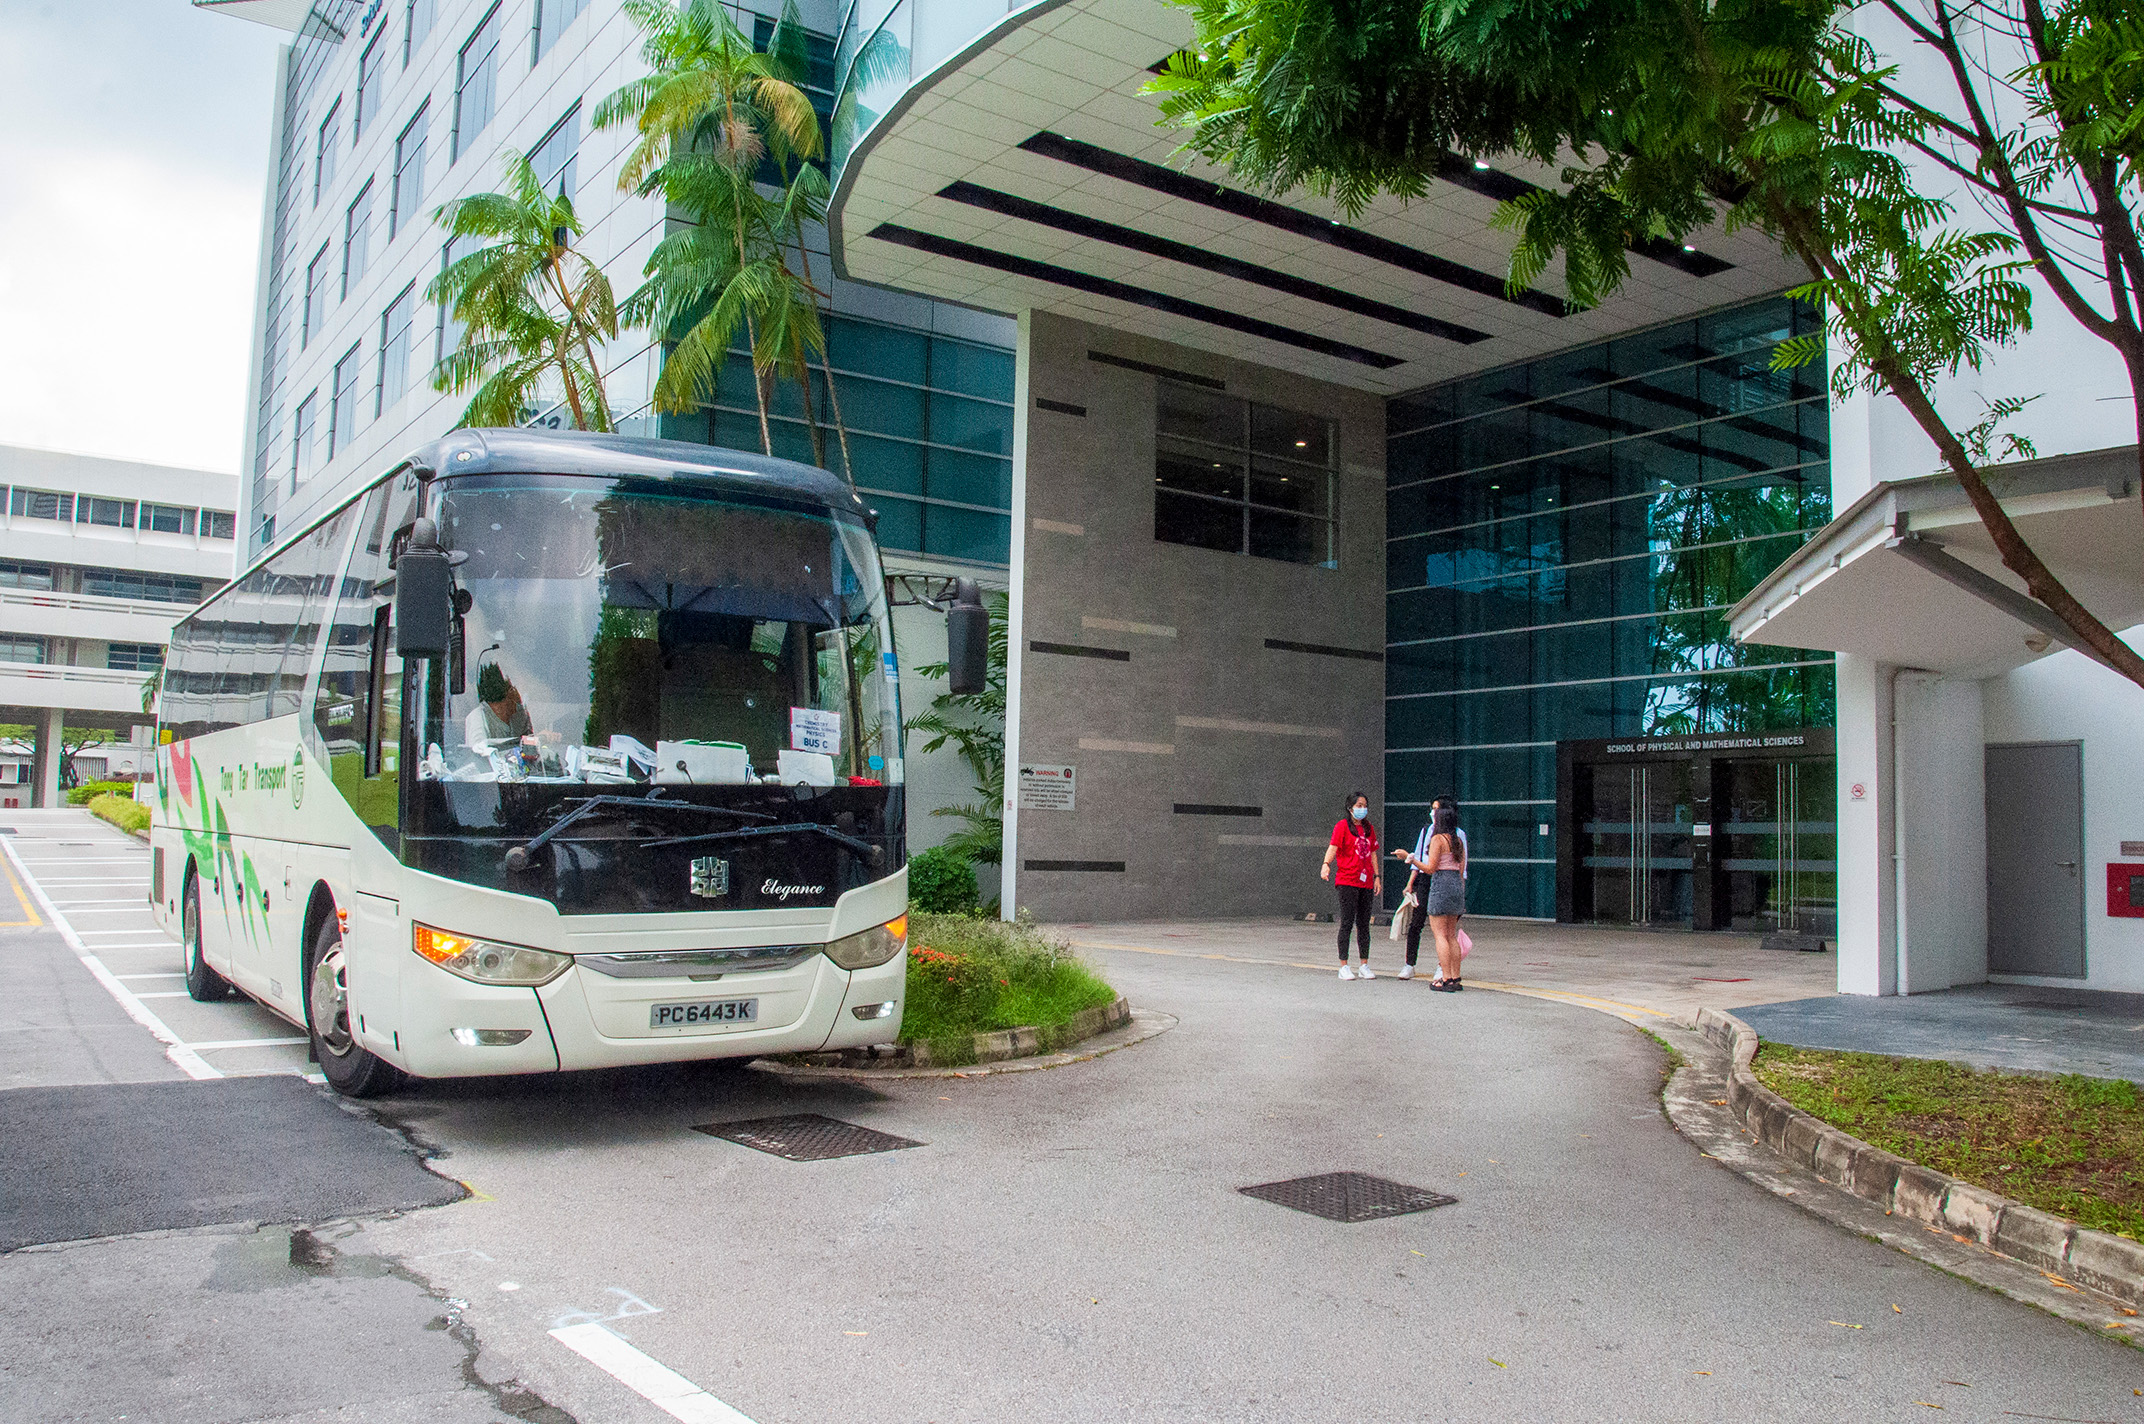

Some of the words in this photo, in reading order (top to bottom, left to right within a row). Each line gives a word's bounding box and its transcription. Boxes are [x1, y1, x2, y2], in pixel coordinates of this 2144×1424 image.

[804, 737, 820, 748] BUS
[822, 740, 828, 749] C
[1607, 744, 1635, 753] SCHOOL
[1636, 743, 1647, 752] OF
[1647, 742, 1684, 751] PHYSICAL
[1685, 741, 1702, 750] AND
[1702, 739, 1762, 749] MATHEMATICAL
[1763, 736, 1805, 746] SCIENCES
[221, 766, 233, 798] Tong
[239, 764, 248, 791] Tar
[254, 760, 286, 798] Transport
[761, 879, 825, 900] Elegance
[659, 1002, 750, 1024] PC6443K
